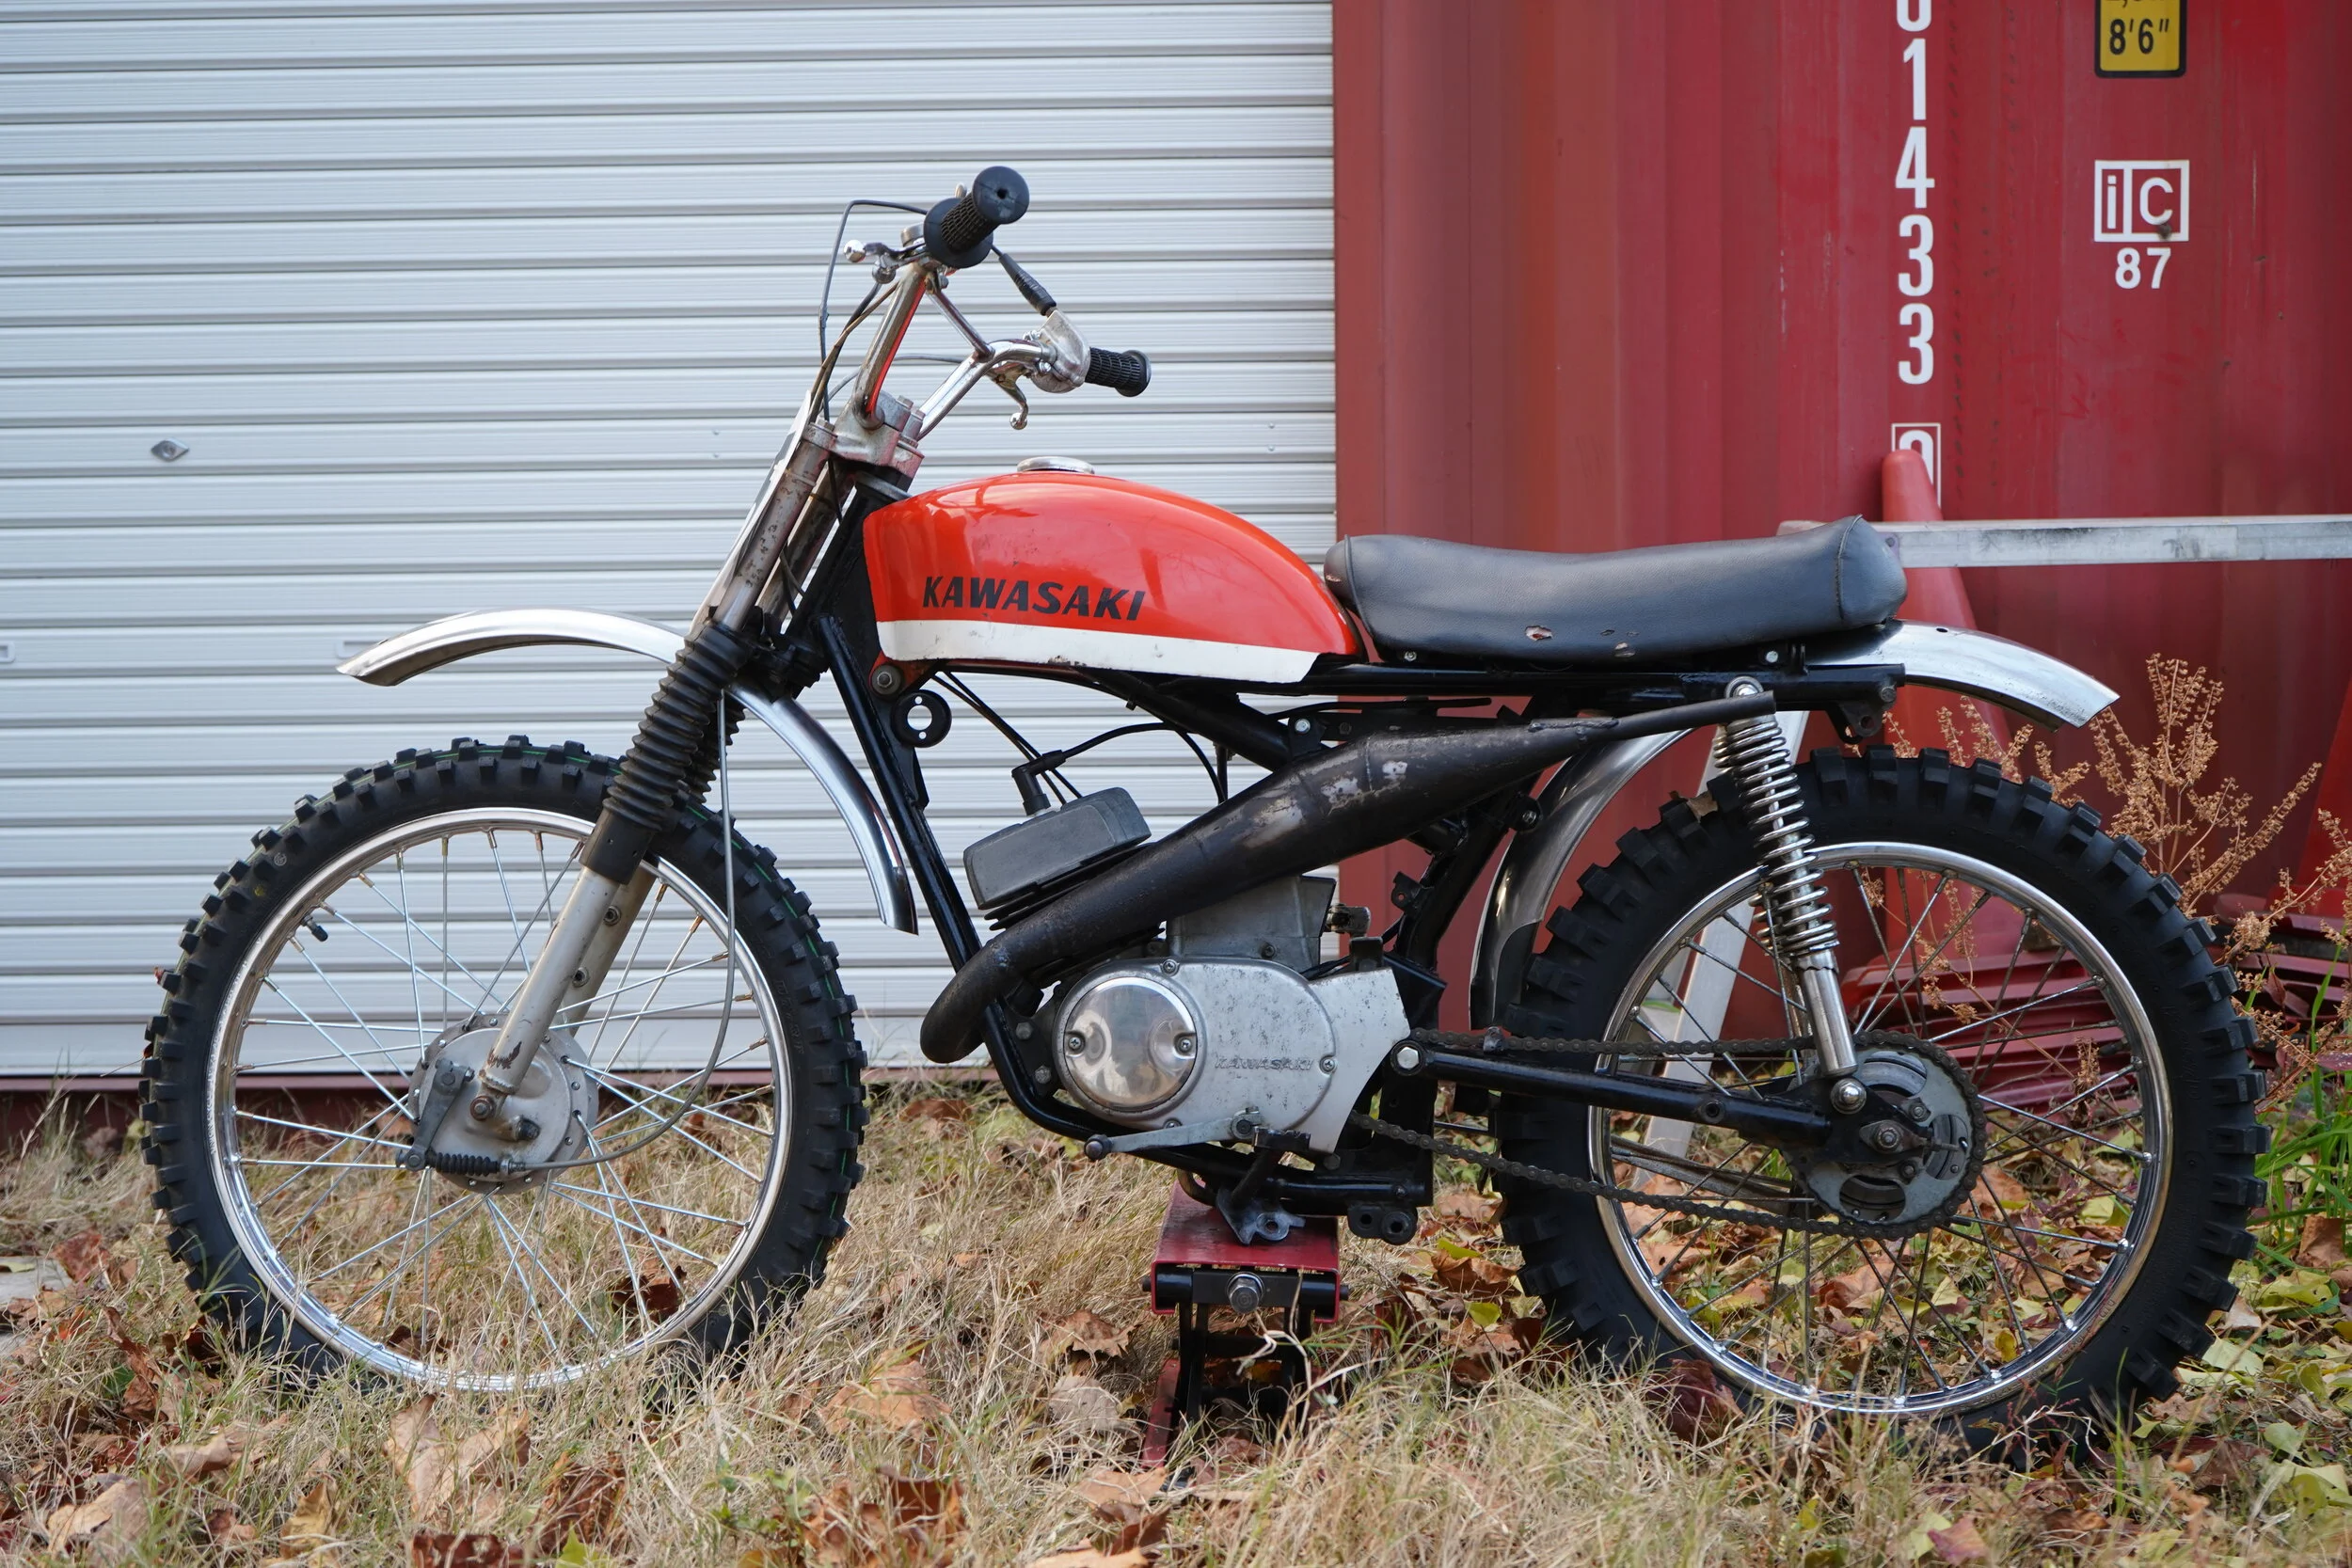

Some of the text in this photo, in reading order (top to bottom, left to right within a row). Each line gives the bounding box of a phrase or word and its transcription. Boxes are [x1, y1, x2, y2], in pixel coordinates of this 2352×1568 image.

[2115, 247, 2171, 289] 87
[922, 576, 1145, 621] KAWASAKI
[1214, 1057, 1315, 1070] KAWASAKI
